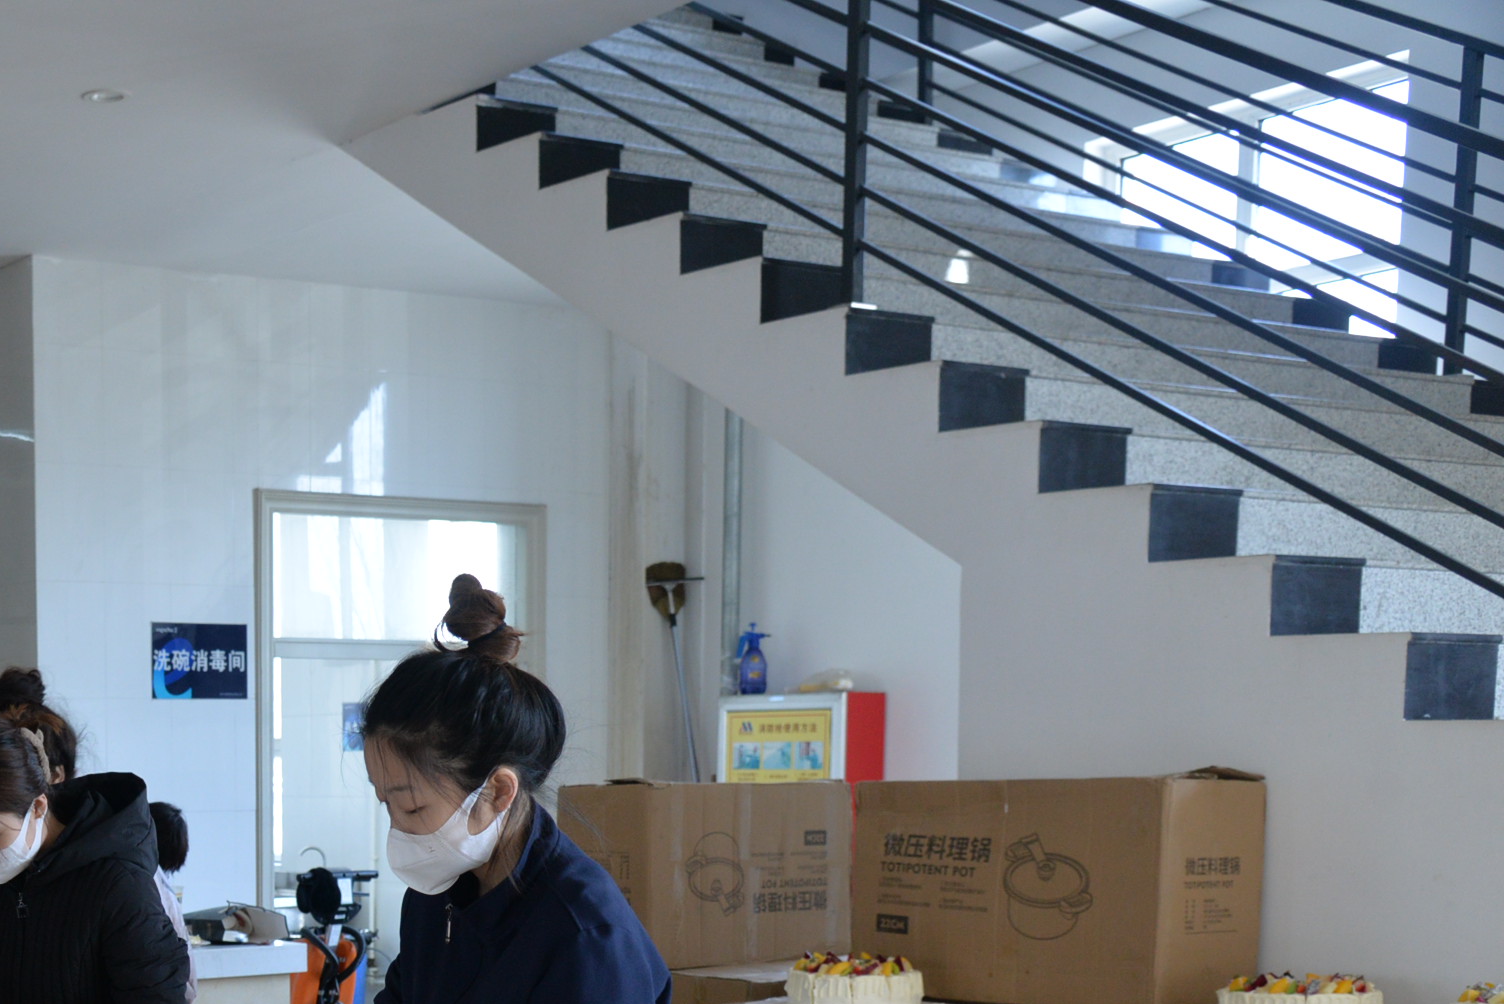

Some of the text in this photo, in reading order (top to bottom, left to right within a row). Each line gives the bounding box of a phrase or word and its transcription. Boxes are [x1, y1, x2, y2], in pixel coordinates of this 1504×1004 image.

[153, 649, 245, 672] 洗碗消毒间
[884, 833, 992, 863] 微压料理锅
[881, 861, 976, 878] TOTIPOTENT POT
[753, 890, 827, 914] 微压料理锅
